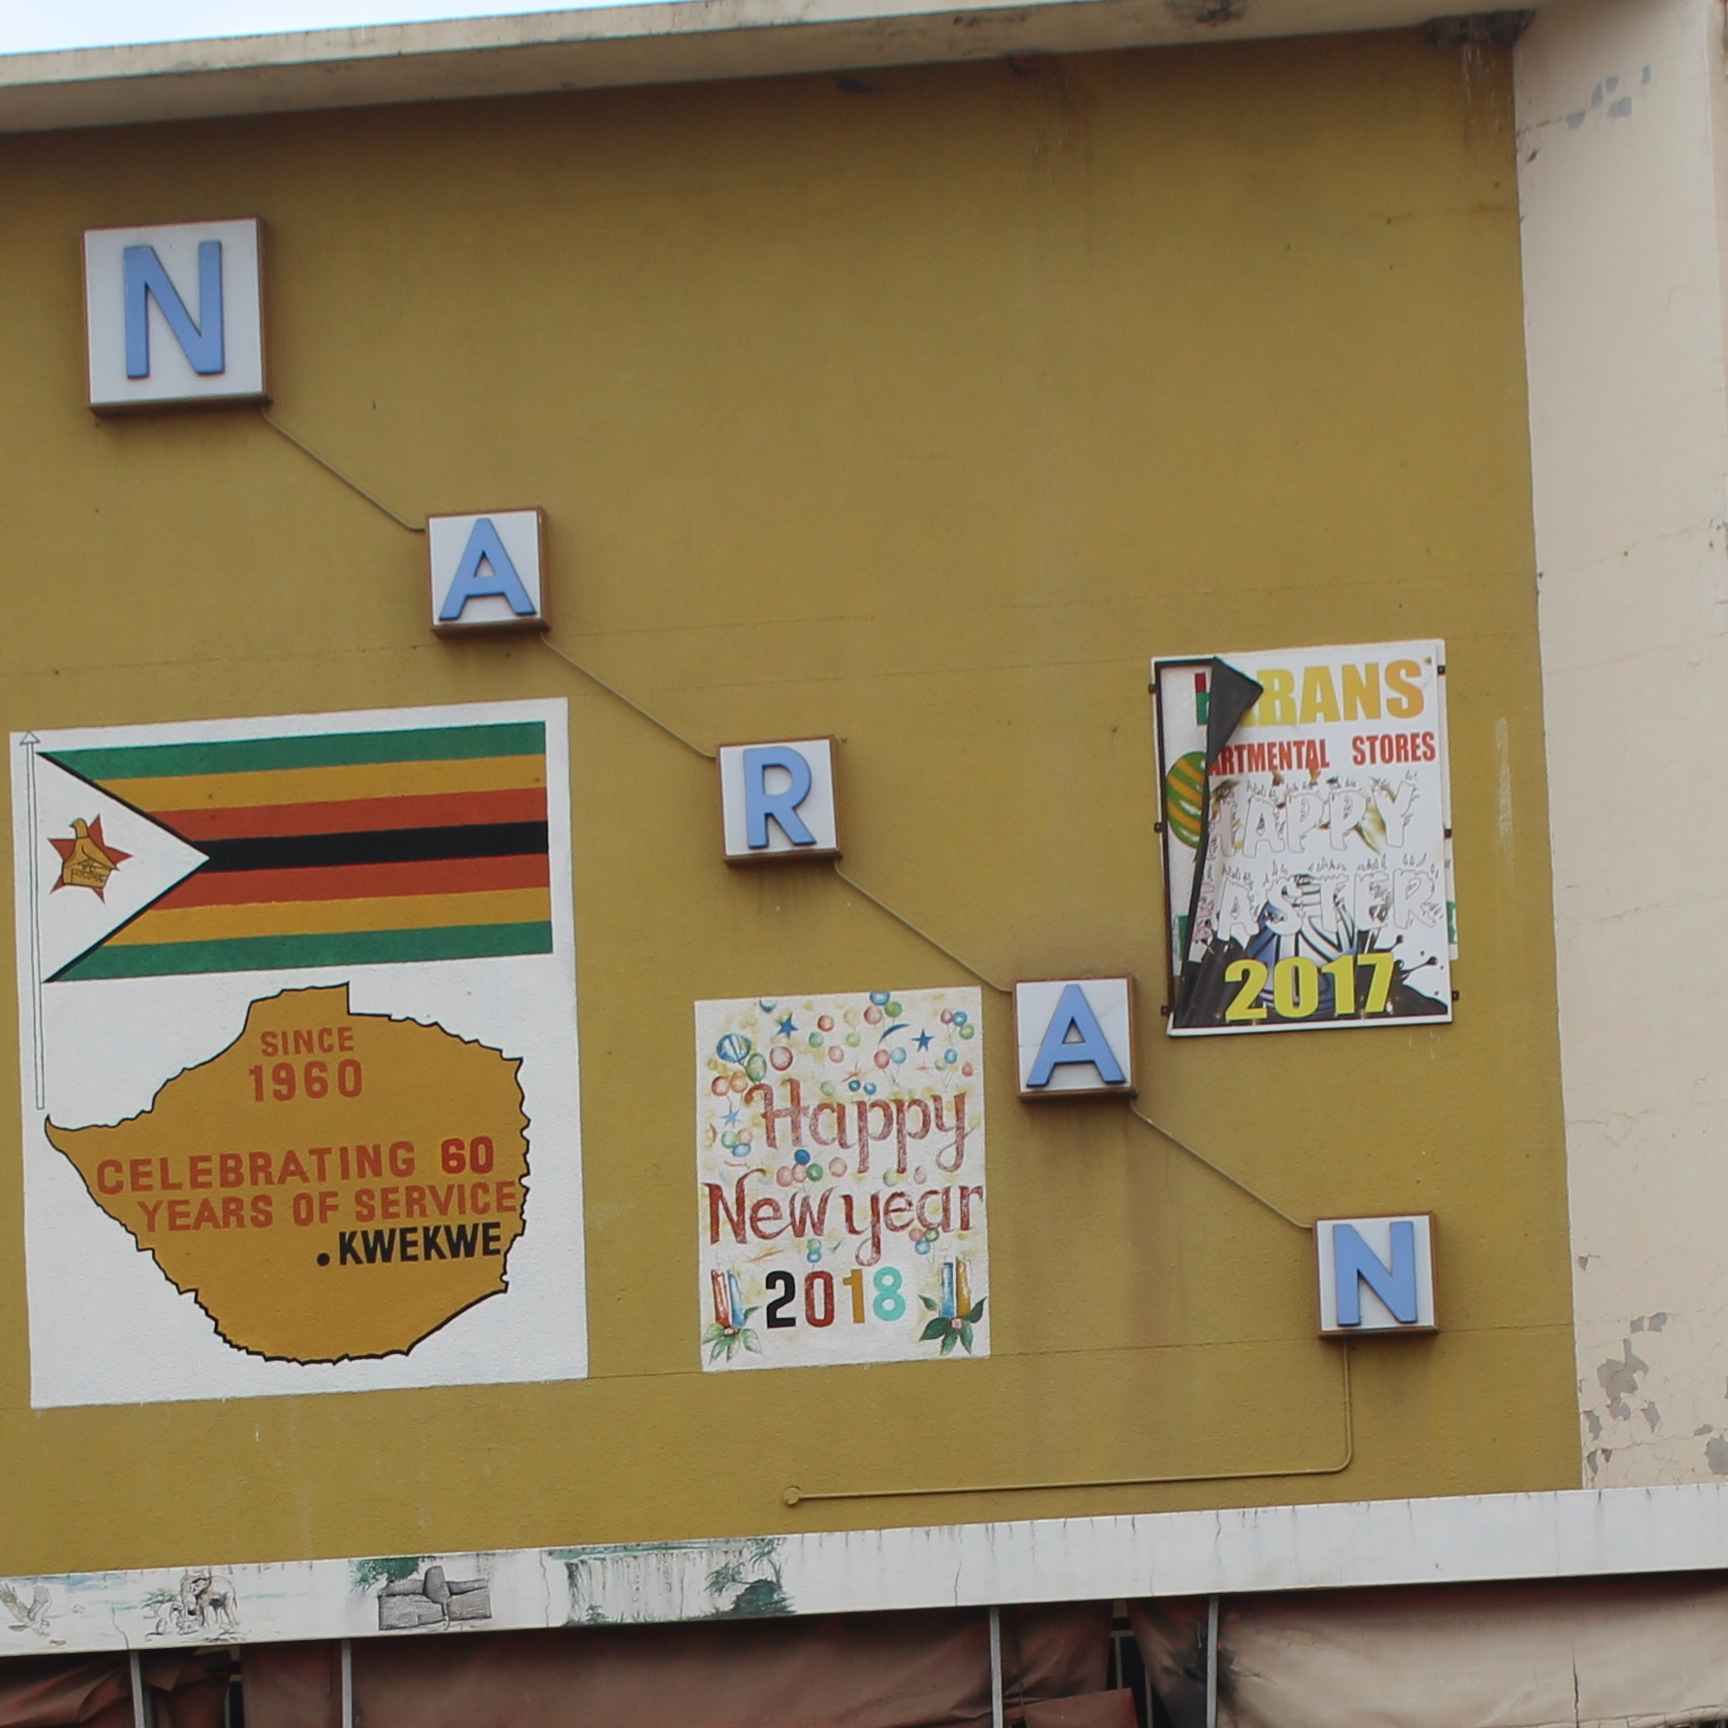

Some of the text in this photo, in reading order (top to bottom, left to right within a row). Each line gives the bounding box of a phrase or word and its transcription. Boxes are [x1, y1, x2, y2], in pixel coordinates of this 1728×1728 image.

[1195, 659, 1425, 728] RANS
[1352, 731, 1437, 766] STORES
[1217, 868, 1439, 942] ASTER
[1224, 952, 1394, 1020] 2017
[259, 1026, 355, 1057] SINCE
[248, 1058, 364, 1102] 1960
[743, 1078, 975, 1174] Happy
[96, 1136, 495, 1196] CELEBRATING 60
[137, 1179, 517, 1233] YEARS OF SERVICE
[701, 1168, 983, 1267] New year
[338, 1221, 502, 1265] KWEKWE
[765, 1266, 906, 1329] 2018
